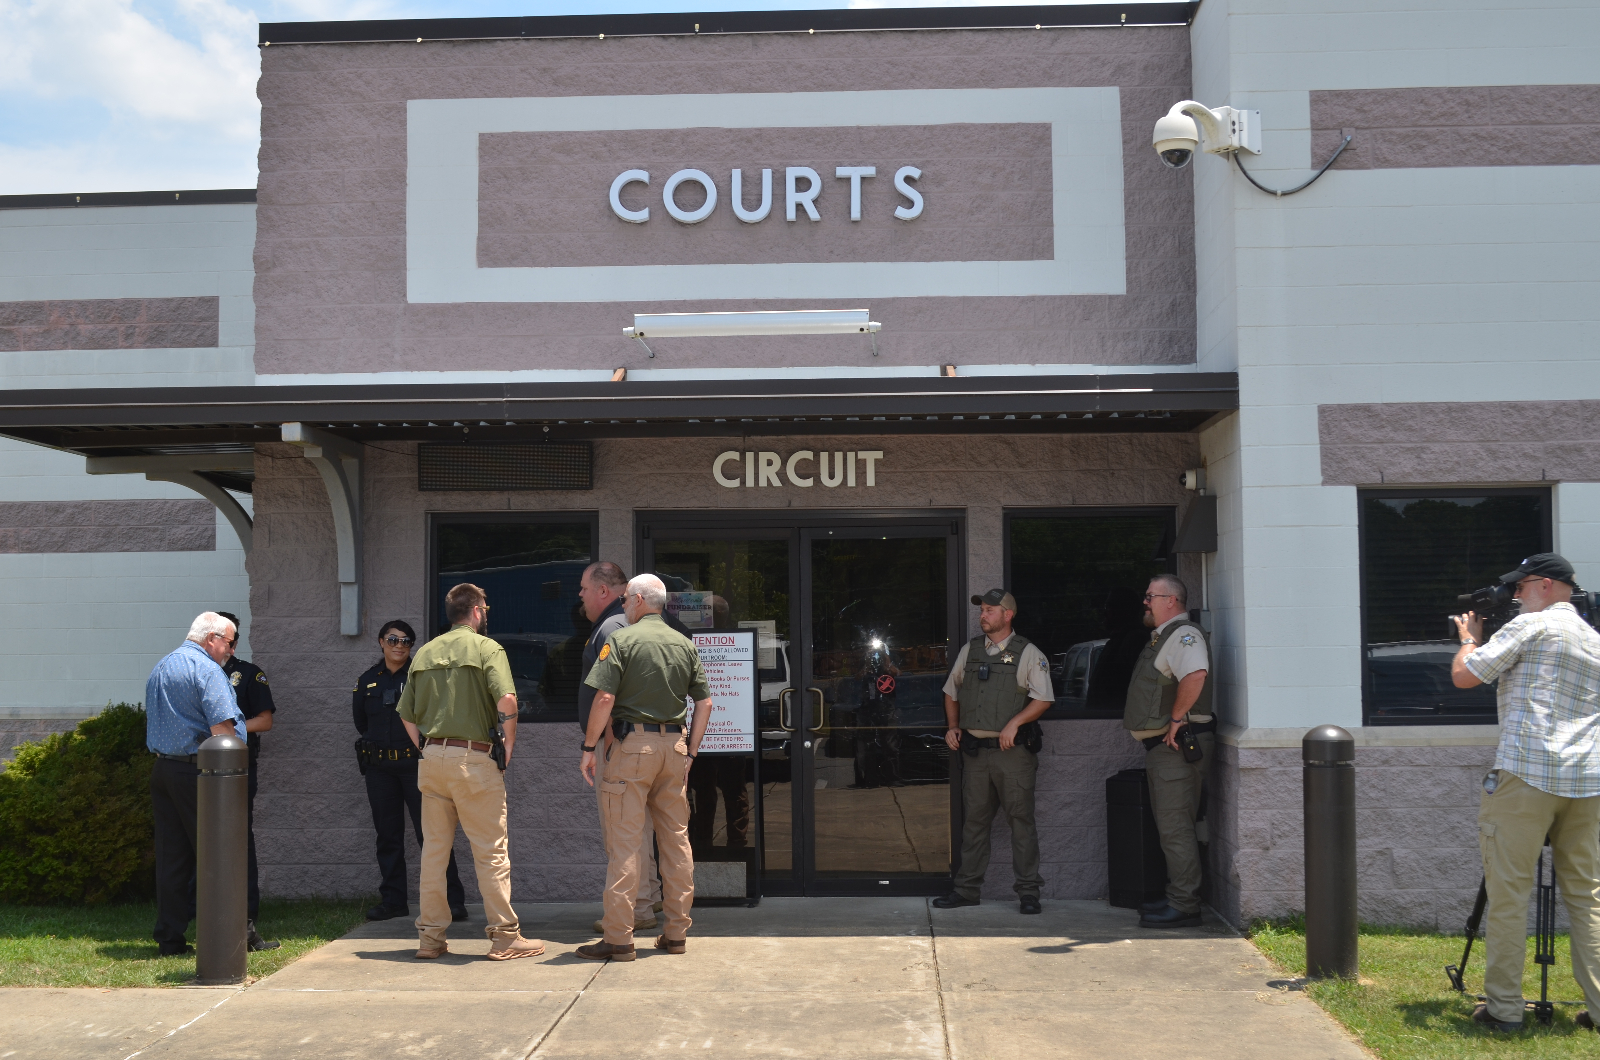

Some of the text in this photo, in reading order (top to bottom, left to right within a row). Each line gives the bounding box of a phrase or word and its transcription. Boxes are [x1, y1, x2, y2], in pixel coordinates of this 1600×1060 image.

[609, 165, 924, 224] COURTS
[712, 450, 884, 488] CIRCUIT
[692, 636, 735, 645] TENTION
